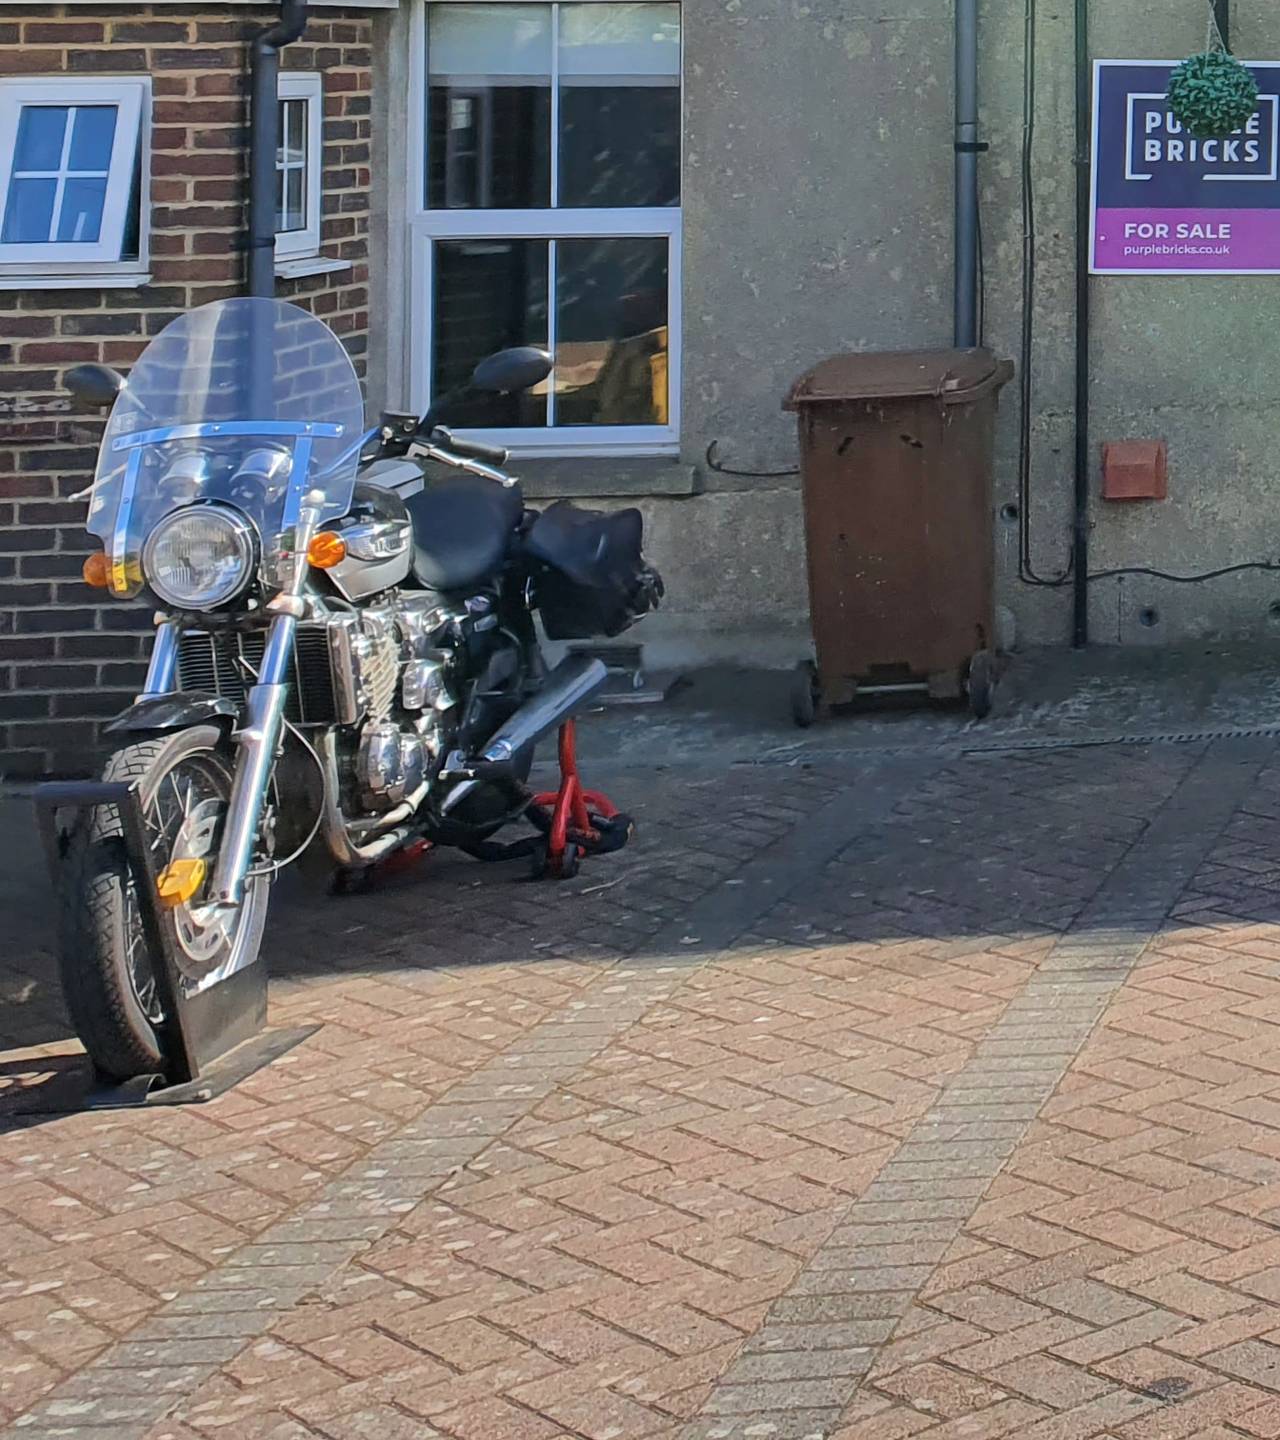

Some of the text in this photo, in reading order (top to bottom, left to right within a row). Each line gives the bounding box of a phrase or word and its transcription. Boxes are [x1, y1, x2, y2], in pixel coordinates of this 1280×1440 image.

[1145, 111, 1260, 135] PUE
[1144, 139, 1260, 162] BRICKS
[1124, 223, 1232, 239] FOR SALE
[1124, 244, 1231, 256] purplebricks.co.uk
